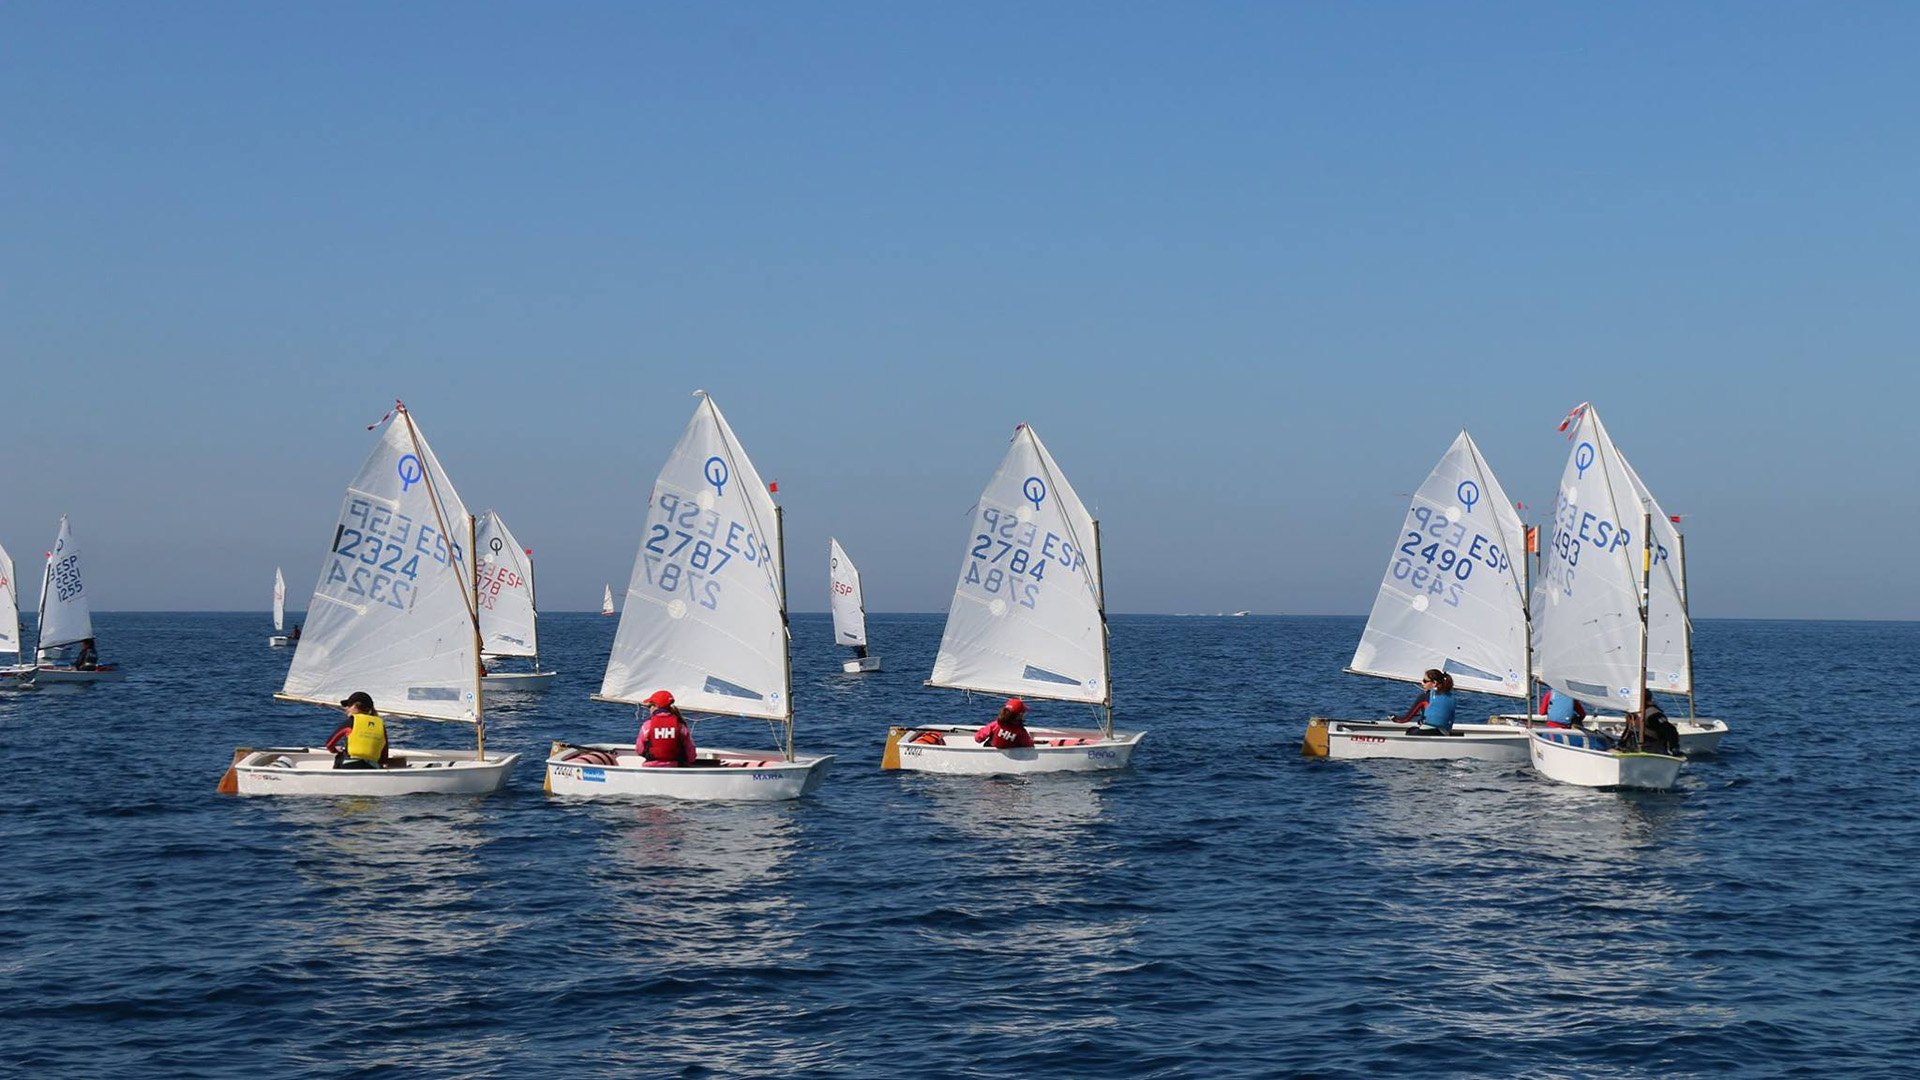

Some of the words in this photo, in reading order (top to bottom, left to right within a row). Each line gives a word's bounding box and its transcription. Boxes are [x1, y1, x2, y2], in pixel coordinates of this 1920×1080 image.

[332, 524, 419, 581] 12324
[416, 525, 462, 567] ESP
[645, 523, 732, 575] 2787
[725, 521, 770, 568] ESP
[1041, 532, 1085, 572] ESP
[1578, 512, 1631, 553] ESP
[56, 555, 77, 575] ESP
[971, 534, 1046, 582] 2784
[1400, 532, 1473, 580] 2490
[1468, 534, 1509, 573] ESP
[58, 580, 83, 602] 1255
[834, 581, 852, 596] ESP
[654, 727, 675, 739] HH
[998, 729, 1016, 742] HH
